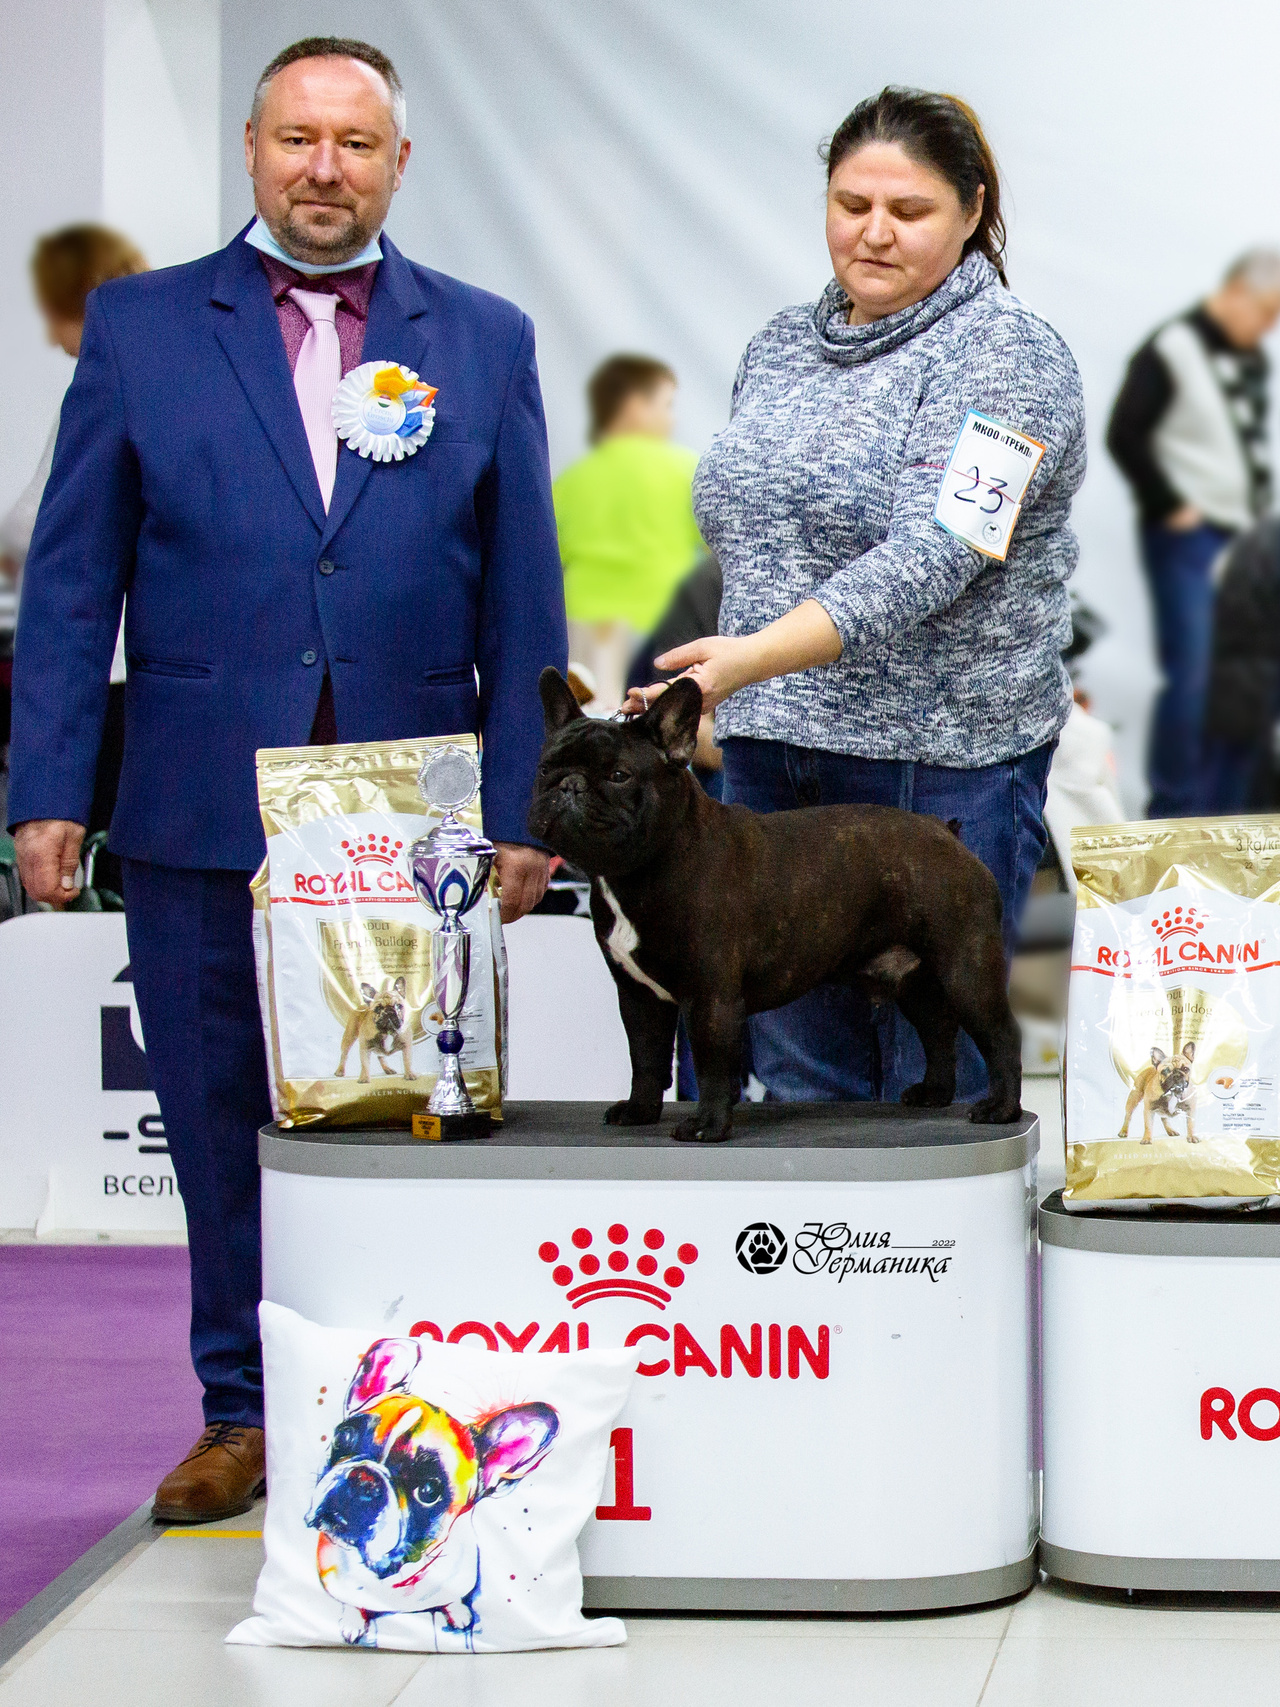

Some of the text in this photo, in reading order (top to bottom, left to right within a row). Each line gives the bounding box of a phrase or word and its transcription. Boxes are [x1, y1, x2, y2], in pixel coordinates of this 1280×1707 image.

[972, 421, 1000, 440] МКОО
[954, 465, 1008, 514] 23
[1236, 838, 1243, 852] 3
[294, 870, 371, 895] ROYAL
[375, 936, 418, 949] Bulldog
[1179, 940, 1259, 964] CANIN
[1172, 1003, 1213, 1018] Bulldog
[103, 1175, 173, 1196] всел
[623, 1322, 830, 1380] CANIN
[595, 1427, 652, 1521] 1
